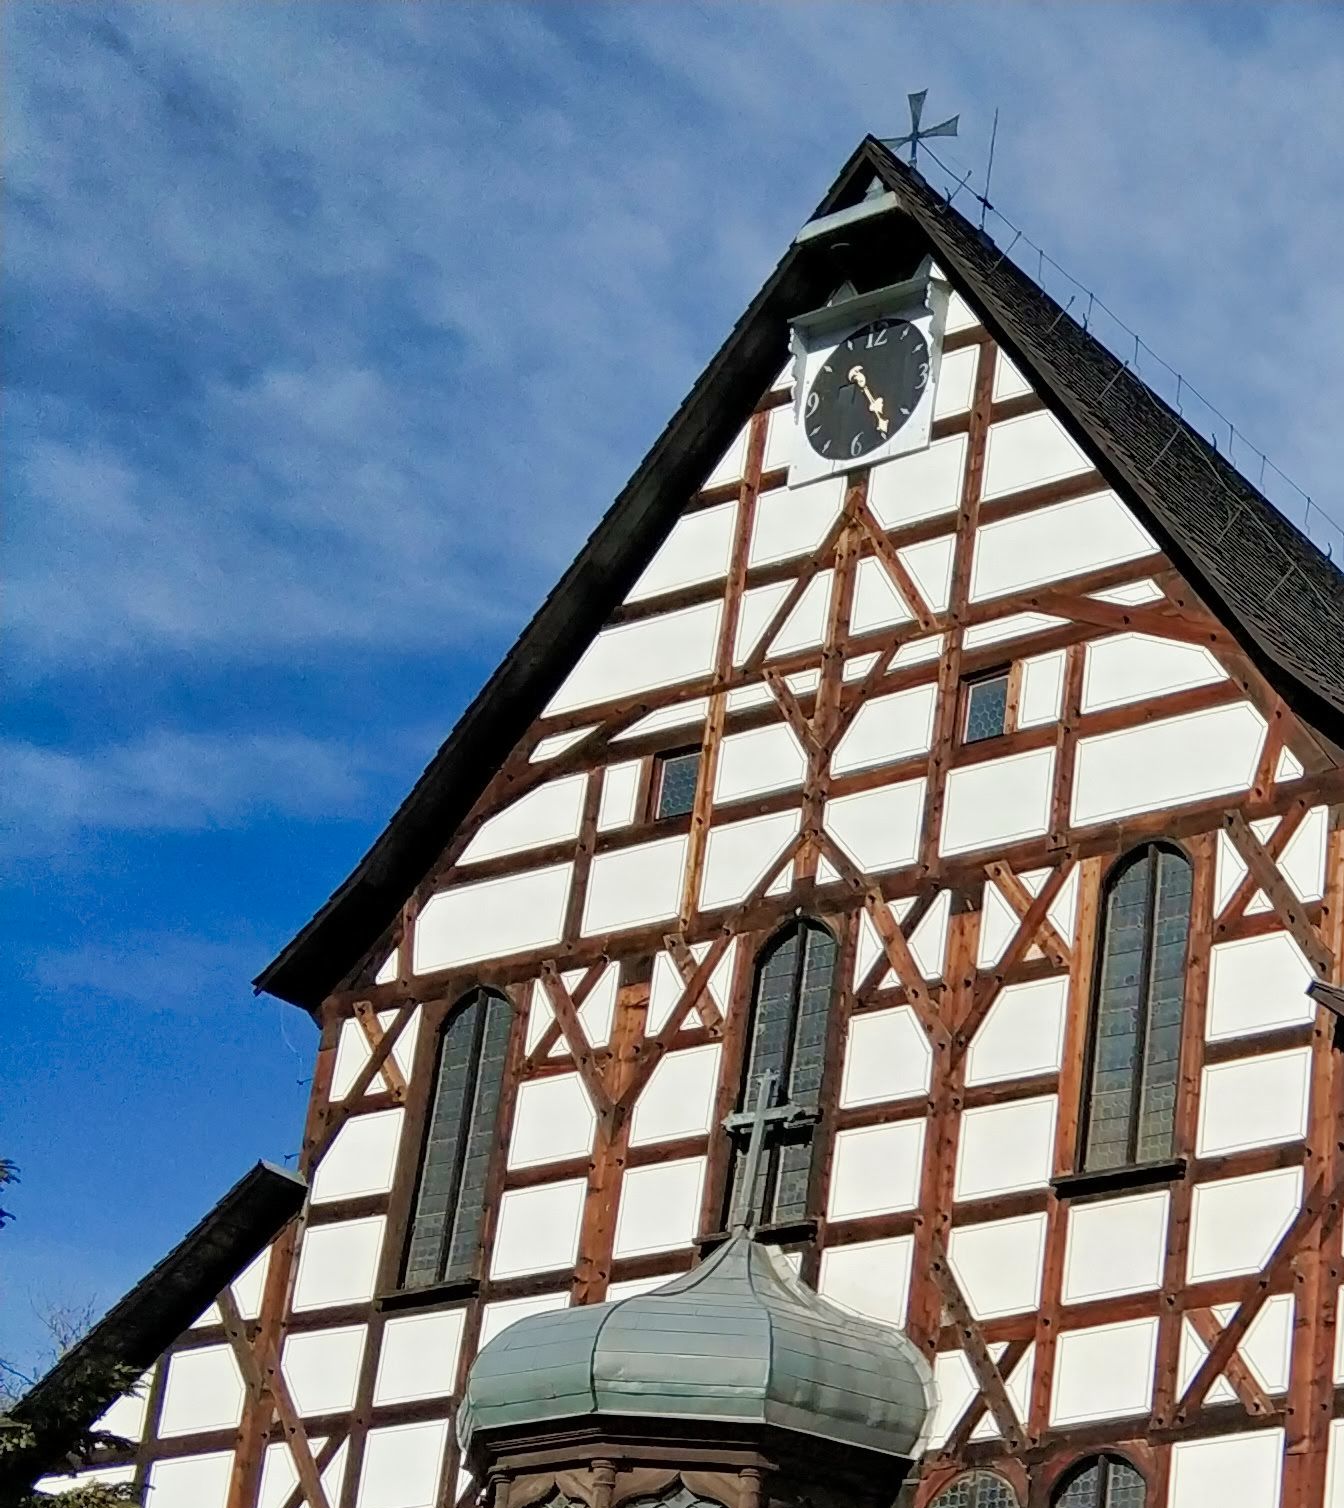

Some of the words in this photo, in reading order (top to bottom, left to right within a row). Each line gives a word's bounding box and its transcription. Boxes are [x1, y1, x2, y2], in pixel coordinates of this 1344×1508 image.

[865, 320, 889, 349] 12
[915, 363, 929, 390] 3
[806, 392, 820, 419] 9
[850, 431, 865, 457] 6
